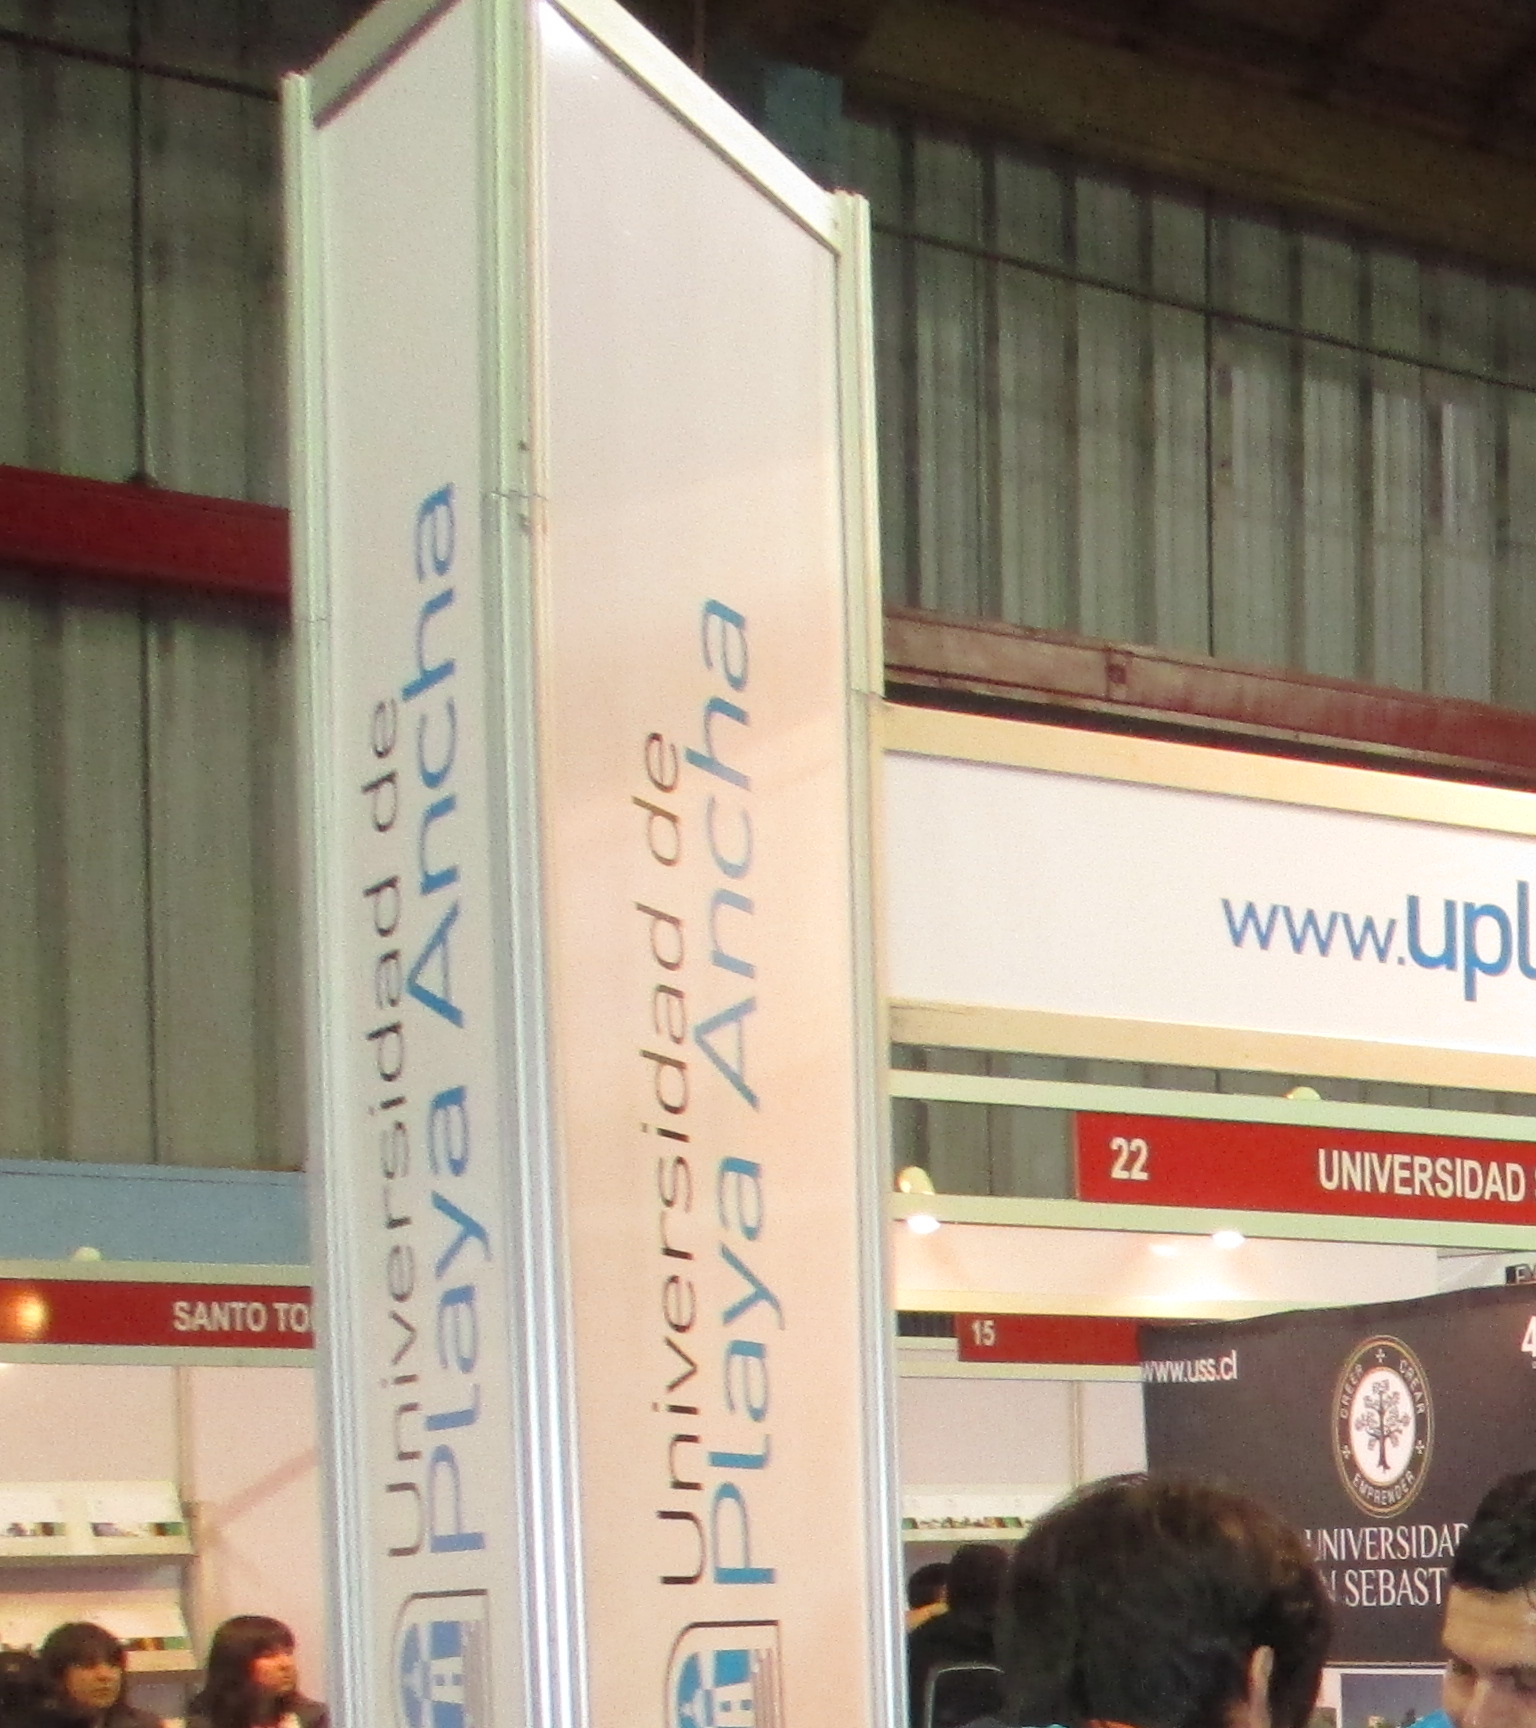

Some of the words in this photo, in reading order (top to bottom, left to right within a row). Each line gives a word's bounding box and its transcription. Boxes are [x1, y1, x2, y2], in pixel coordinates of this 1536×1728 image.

[360, 697, 399, 833] de
[402, 482, 466, 1029] Ancha
[631, 731, 682, 867] de
[686, 598, 761, 1113] Ancha
[364, 876, 424, 1558] Universidad
[1109, 1137, 1149, 1181] 22
[1317, 1148, 1527, 1202] UNIVERSIDAD
[635, 902, 708, 1586] Universidad
[172, 1300, 268, 1333] SANTO
[425, 1085, 491, 1554] Playa
[708, 1158, 785, 1586] Playa
[971, 1319, 997, 1347] 15
[1141, 1350, 1238, 1383] www.uss.cl
[1345, 1567, 1448, 1607] SEBAST
